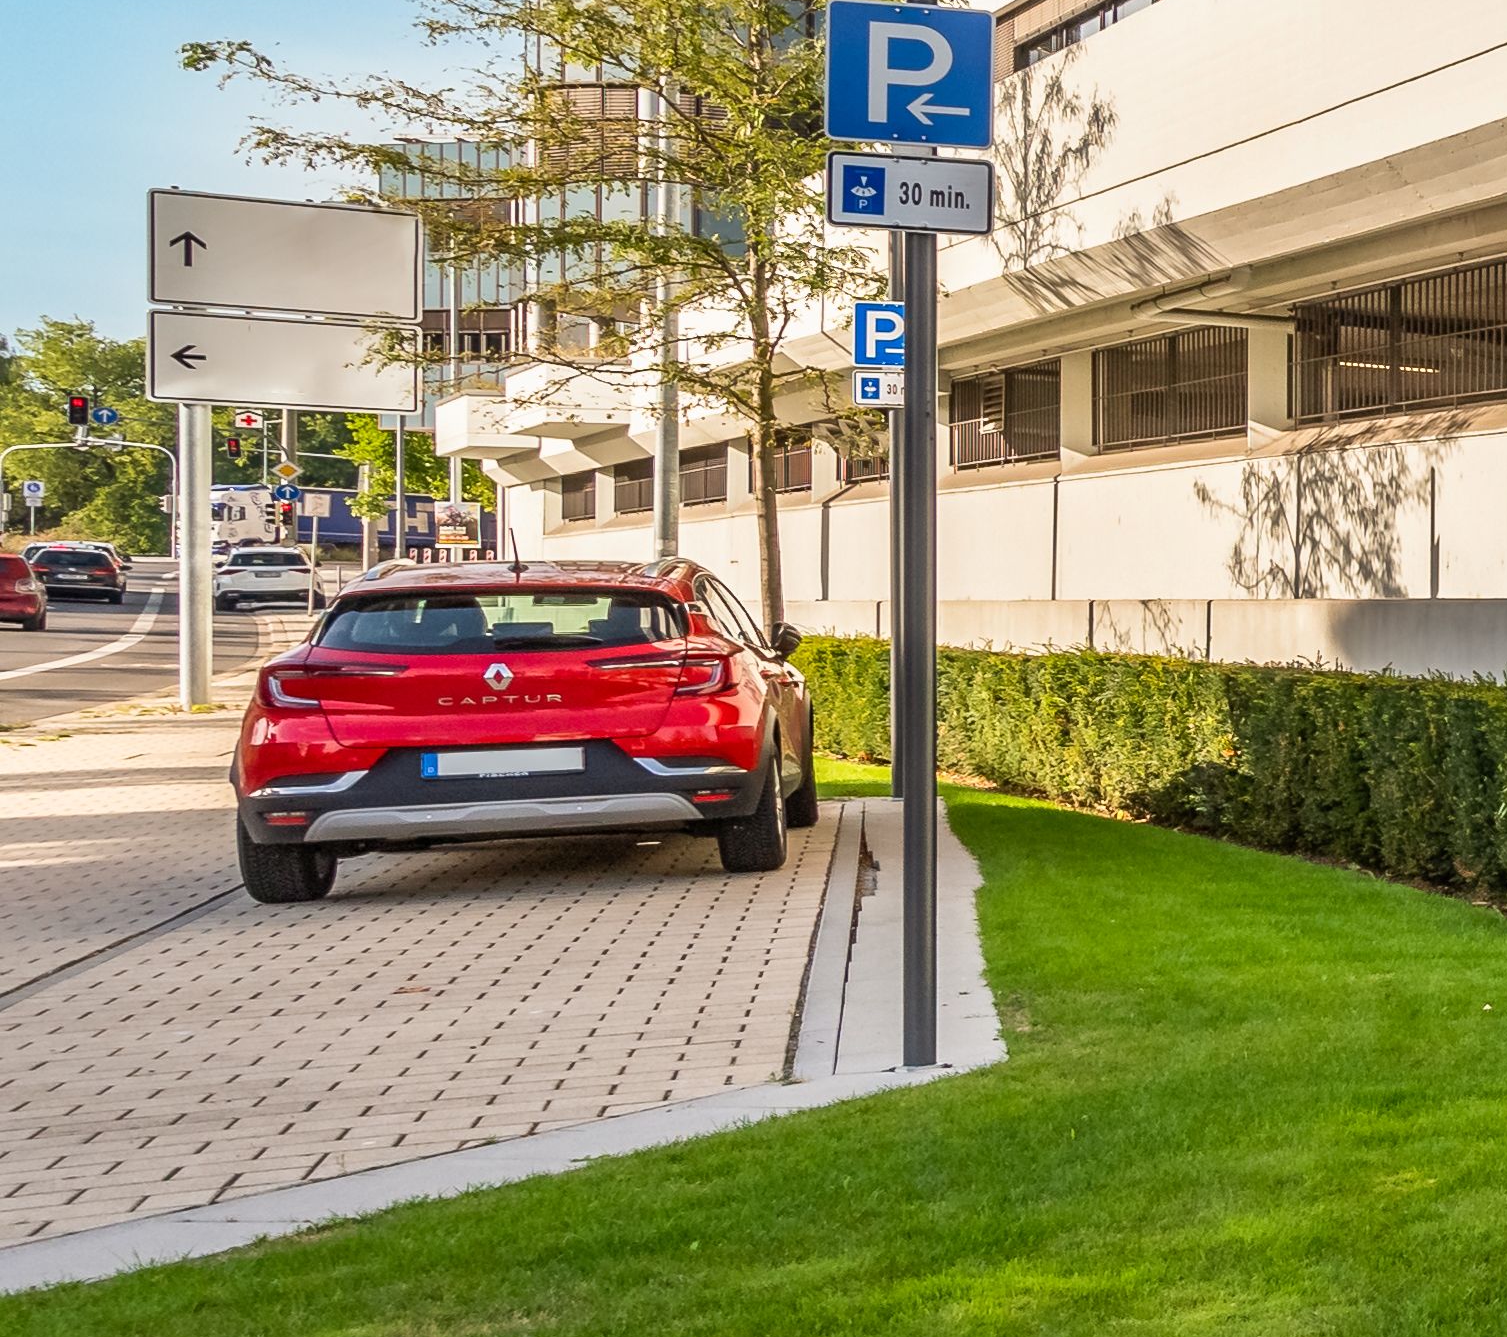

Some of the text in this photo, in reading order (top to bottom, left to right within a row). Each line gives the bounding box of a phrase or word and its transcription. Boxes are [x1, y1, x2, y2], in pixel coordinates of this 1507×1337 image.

[868, 21, 953, 123] P
[899, 181, 970, 210] 30 min.
[865, 310, 905, 358] P
[886, 384, 898, 395] 30
[438, 694, 562, 706] CAPTUR
